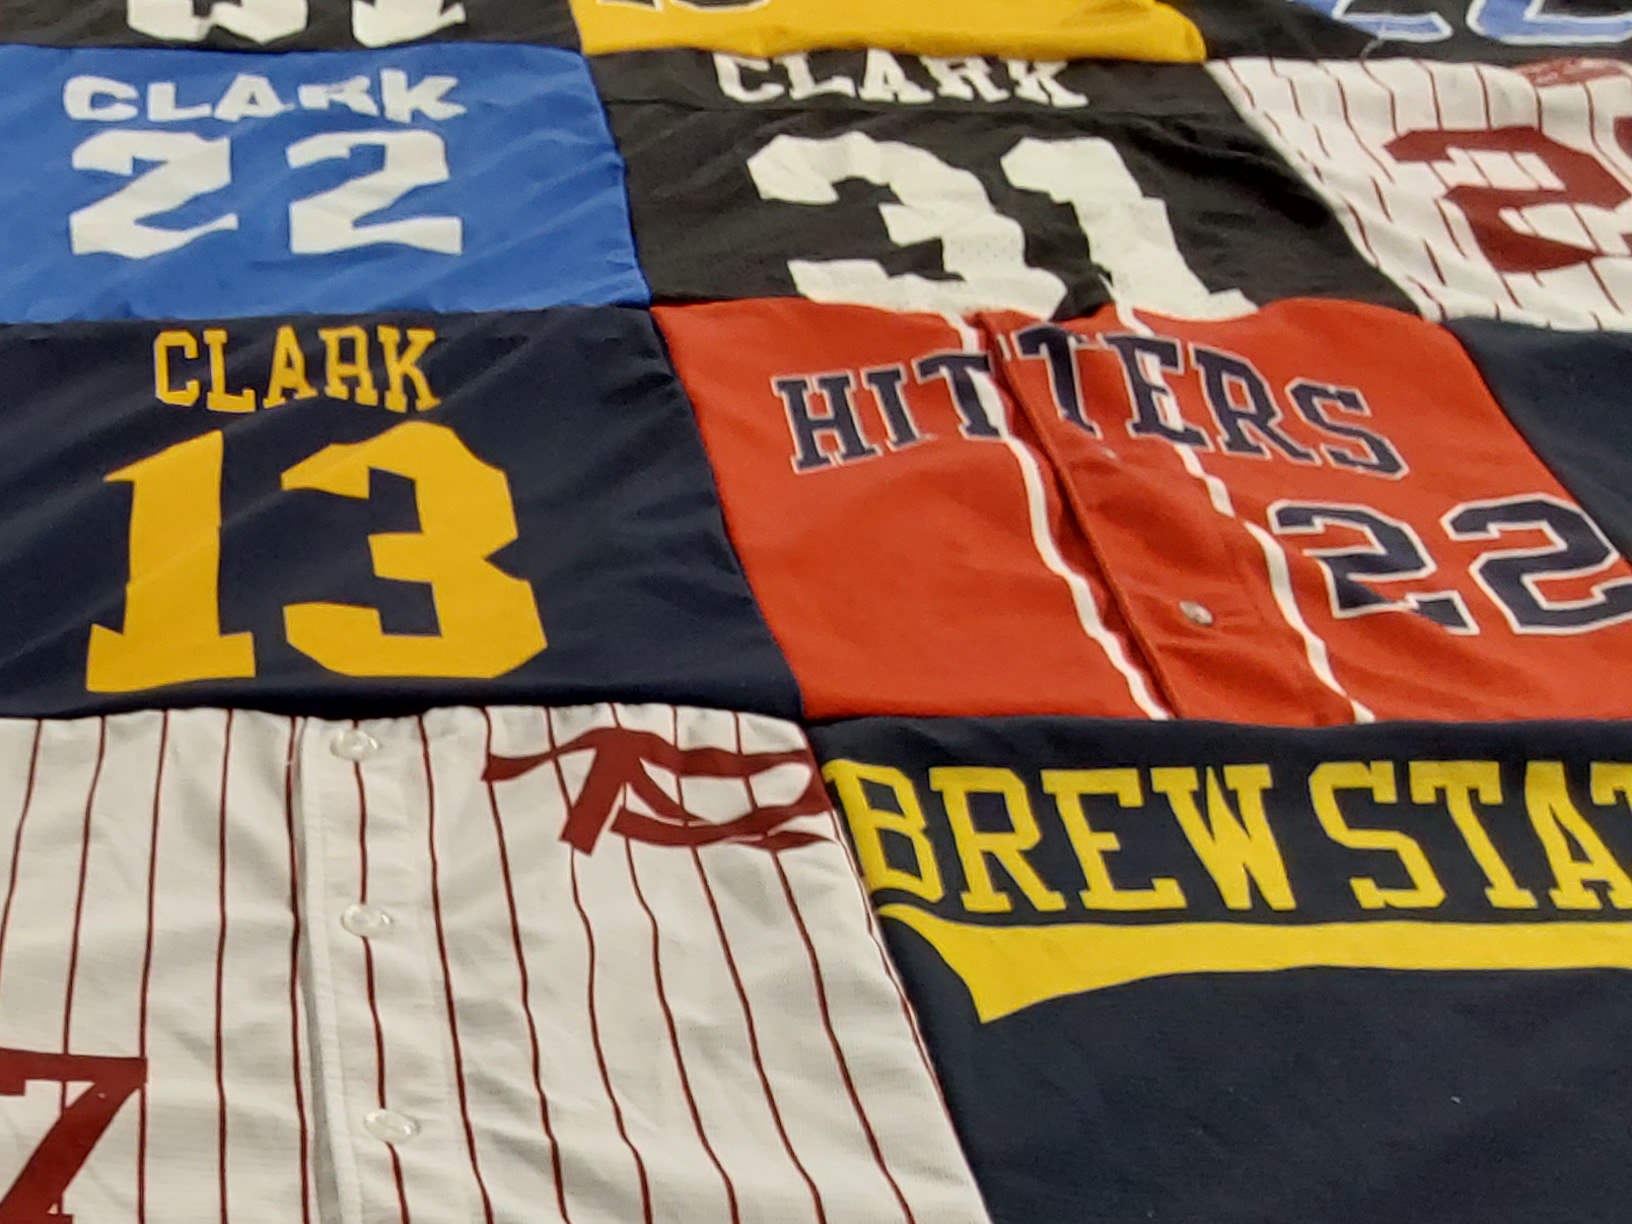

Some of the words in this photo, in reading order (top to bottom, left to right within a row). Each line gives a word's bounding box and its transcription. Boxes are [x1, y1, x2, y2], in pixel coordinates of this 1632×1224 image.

[63, 68, 466, 123] CLARK
[713, 48, 1088, 108] CLARK
[70, 129, 462, 259] 22
[747, 131, 1259, 320] 31
[1383, 115, 1632, 275] 2
[154, 325, 440, 413] CLARK
[772, 321, 1410, 478] HITTERS
[85, 420, 549, 693] 13
[1267, 493, 1632, 634] 22
[821, 758, 1297, 913] BREW
